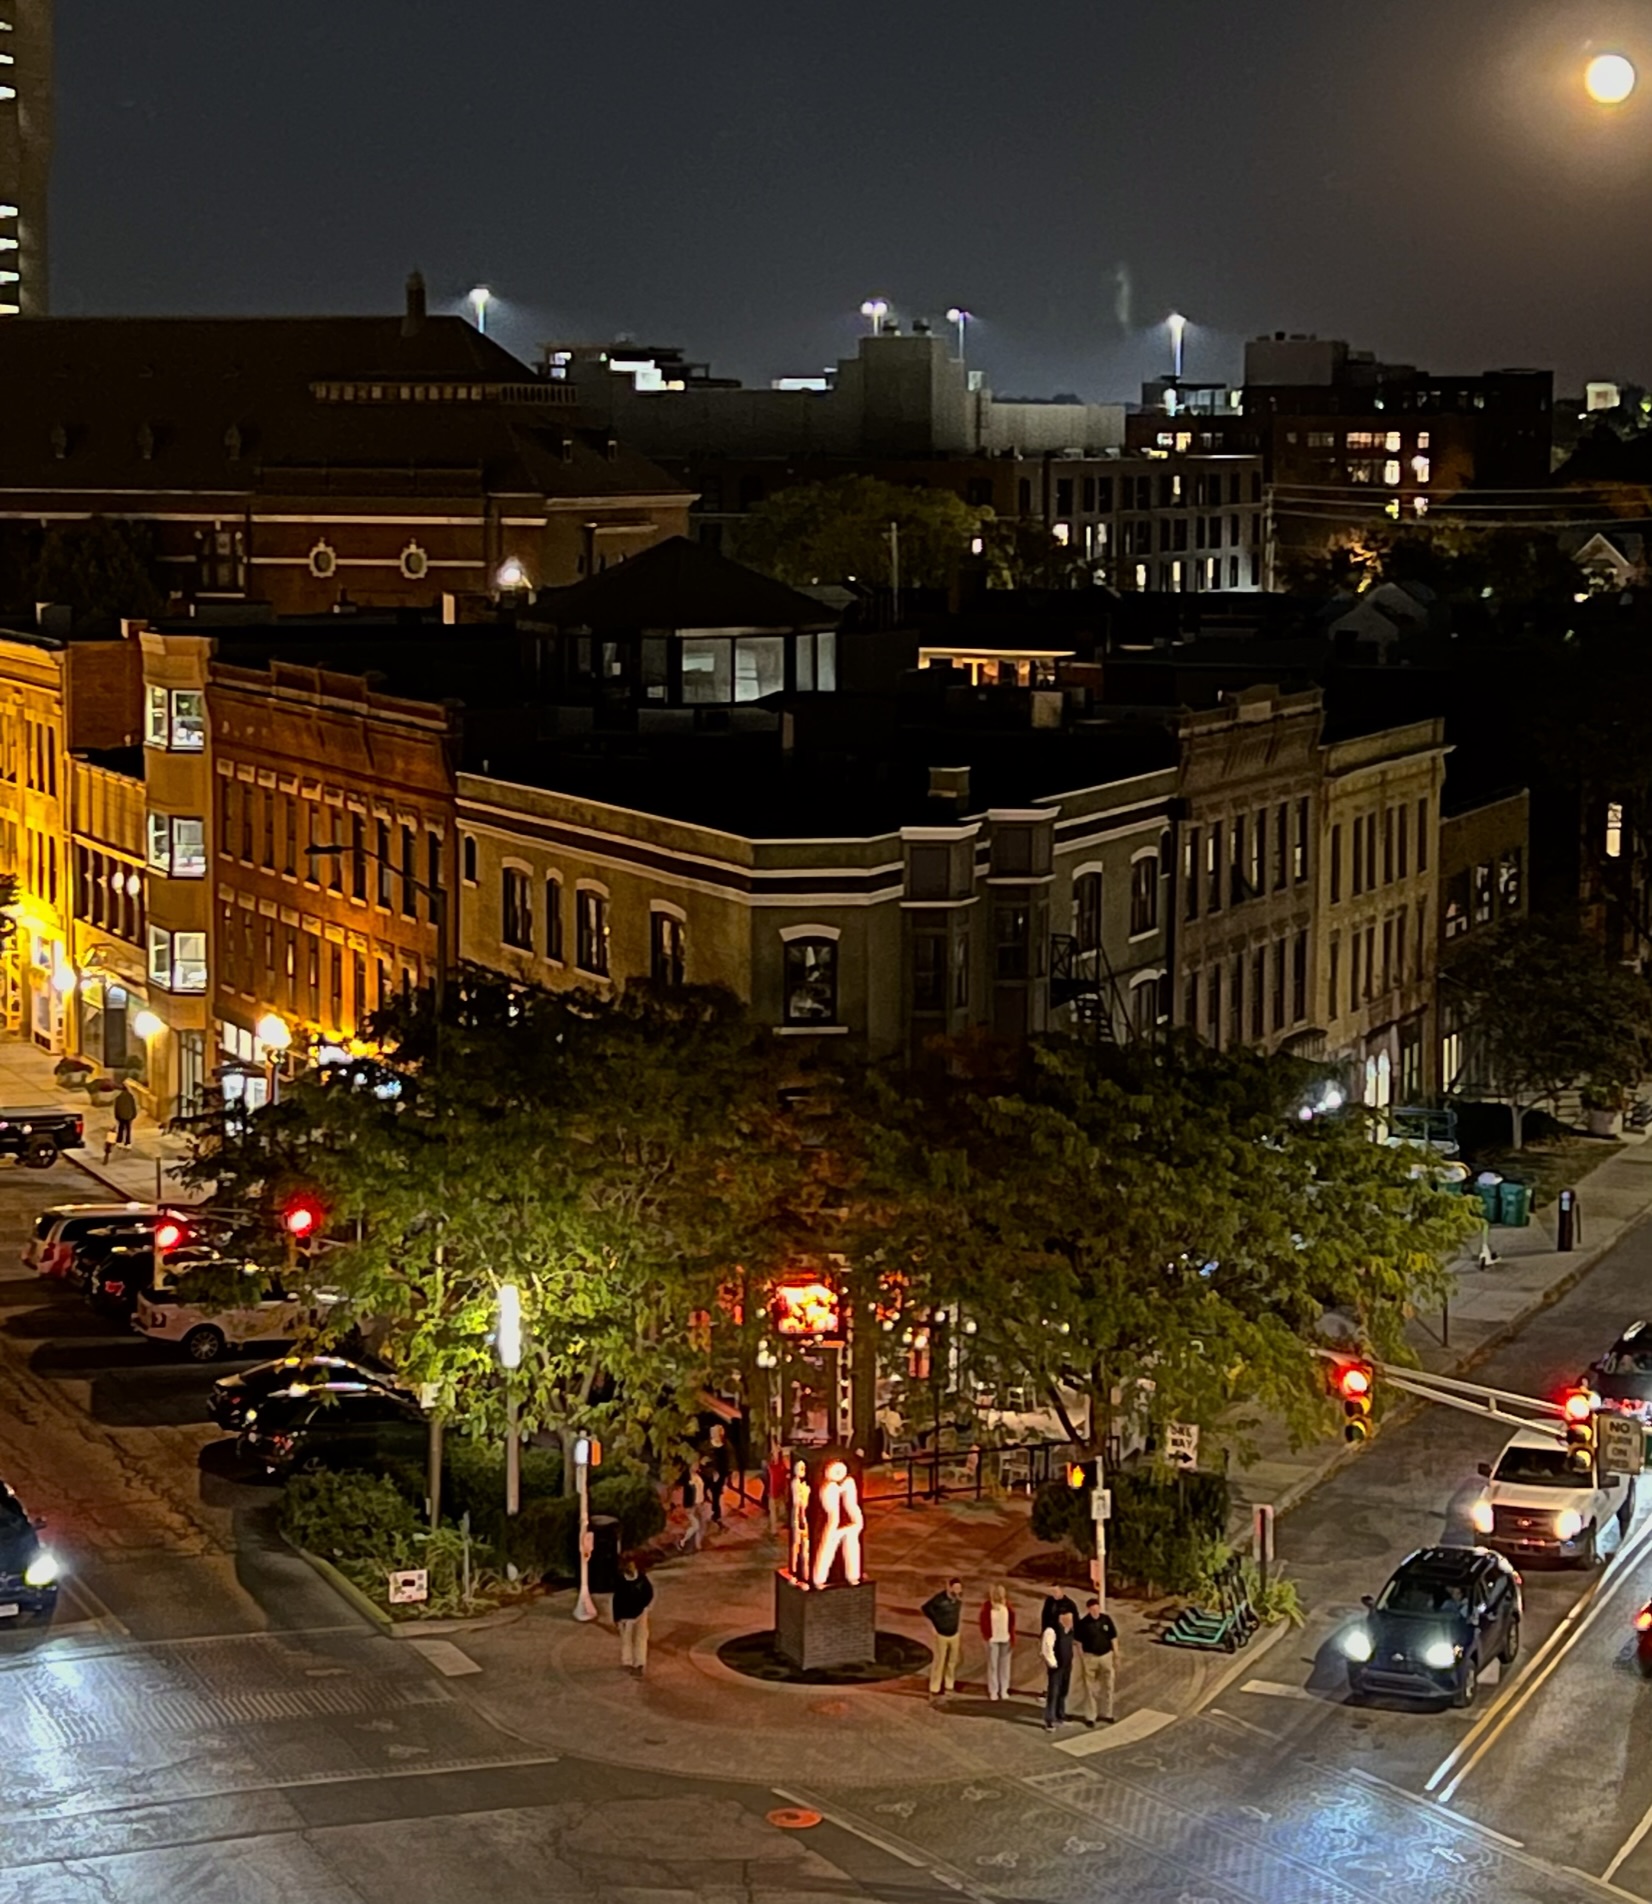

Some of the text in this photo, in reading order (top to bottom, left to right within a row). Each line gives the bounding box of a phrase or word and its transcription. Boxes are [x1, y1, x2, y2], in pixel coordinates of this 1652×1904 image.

[1609, 1421, 1630, 1433] NO
[1171, 1438, 1193, 1448] WAY
[1611, 1447, 1627, 1457] ON
